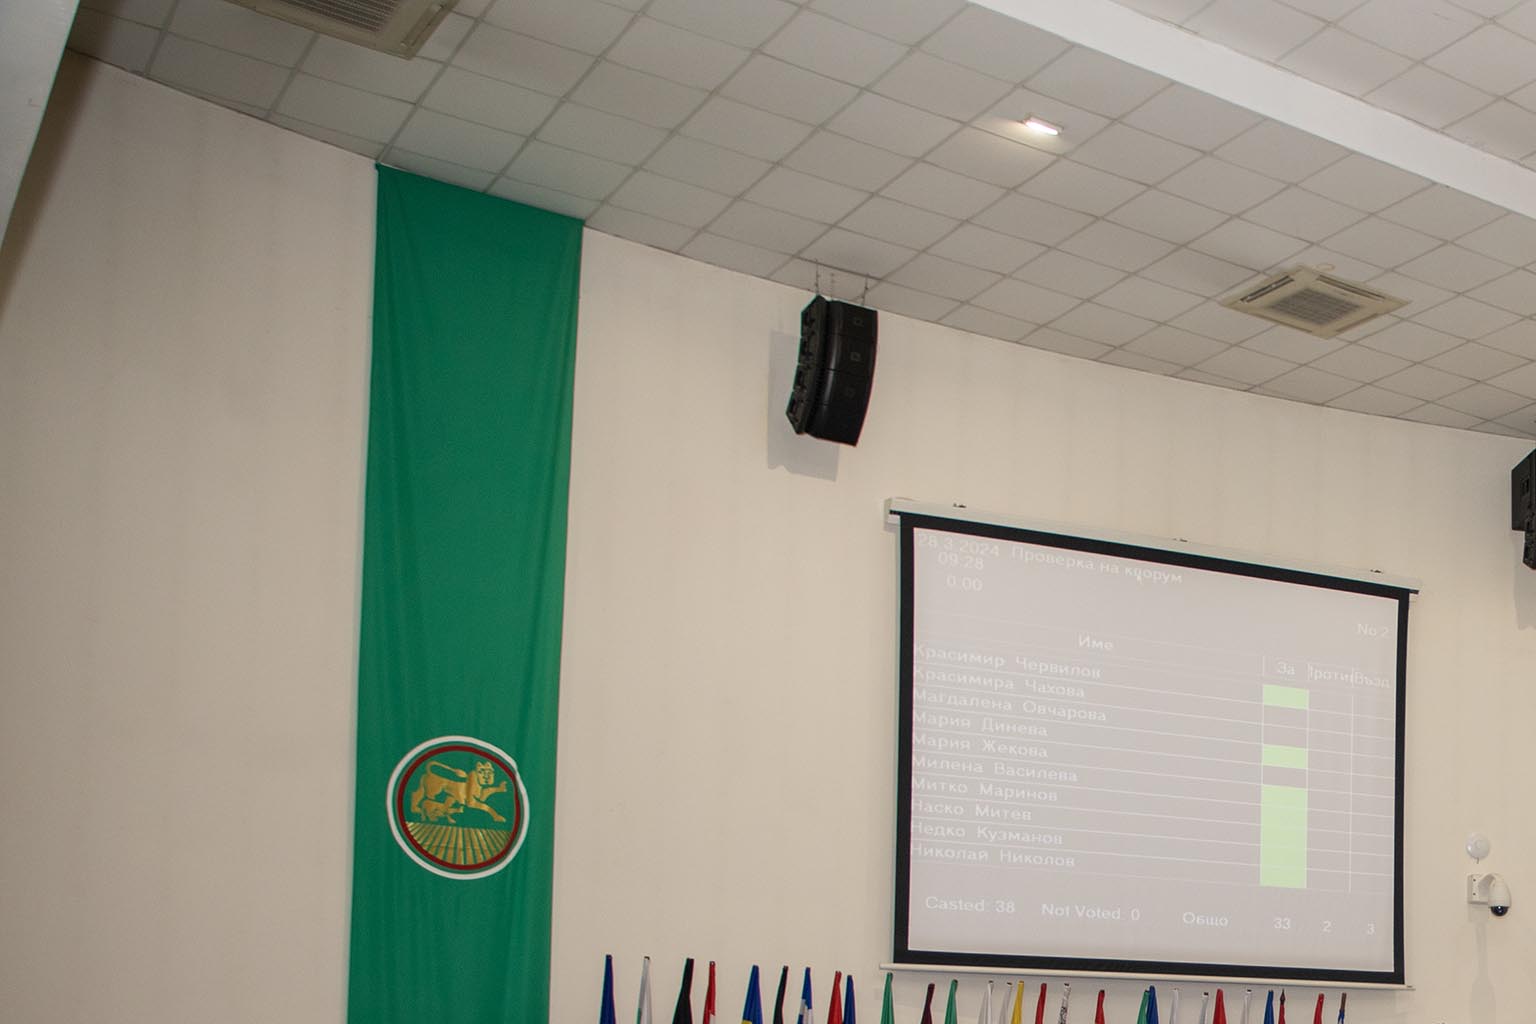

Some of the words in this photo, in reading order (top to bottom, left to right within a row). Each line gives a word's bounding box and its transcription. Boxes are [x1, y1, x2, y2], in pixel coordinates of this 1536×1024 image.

[1011, 545, 1096, 570] Проверка
[1100, 562, 1120, 576] на
[1079, 632, 1115, 651] Име
[1000, 847, 1076, 868] Николов
[995, 899, 1016, 913] 38
